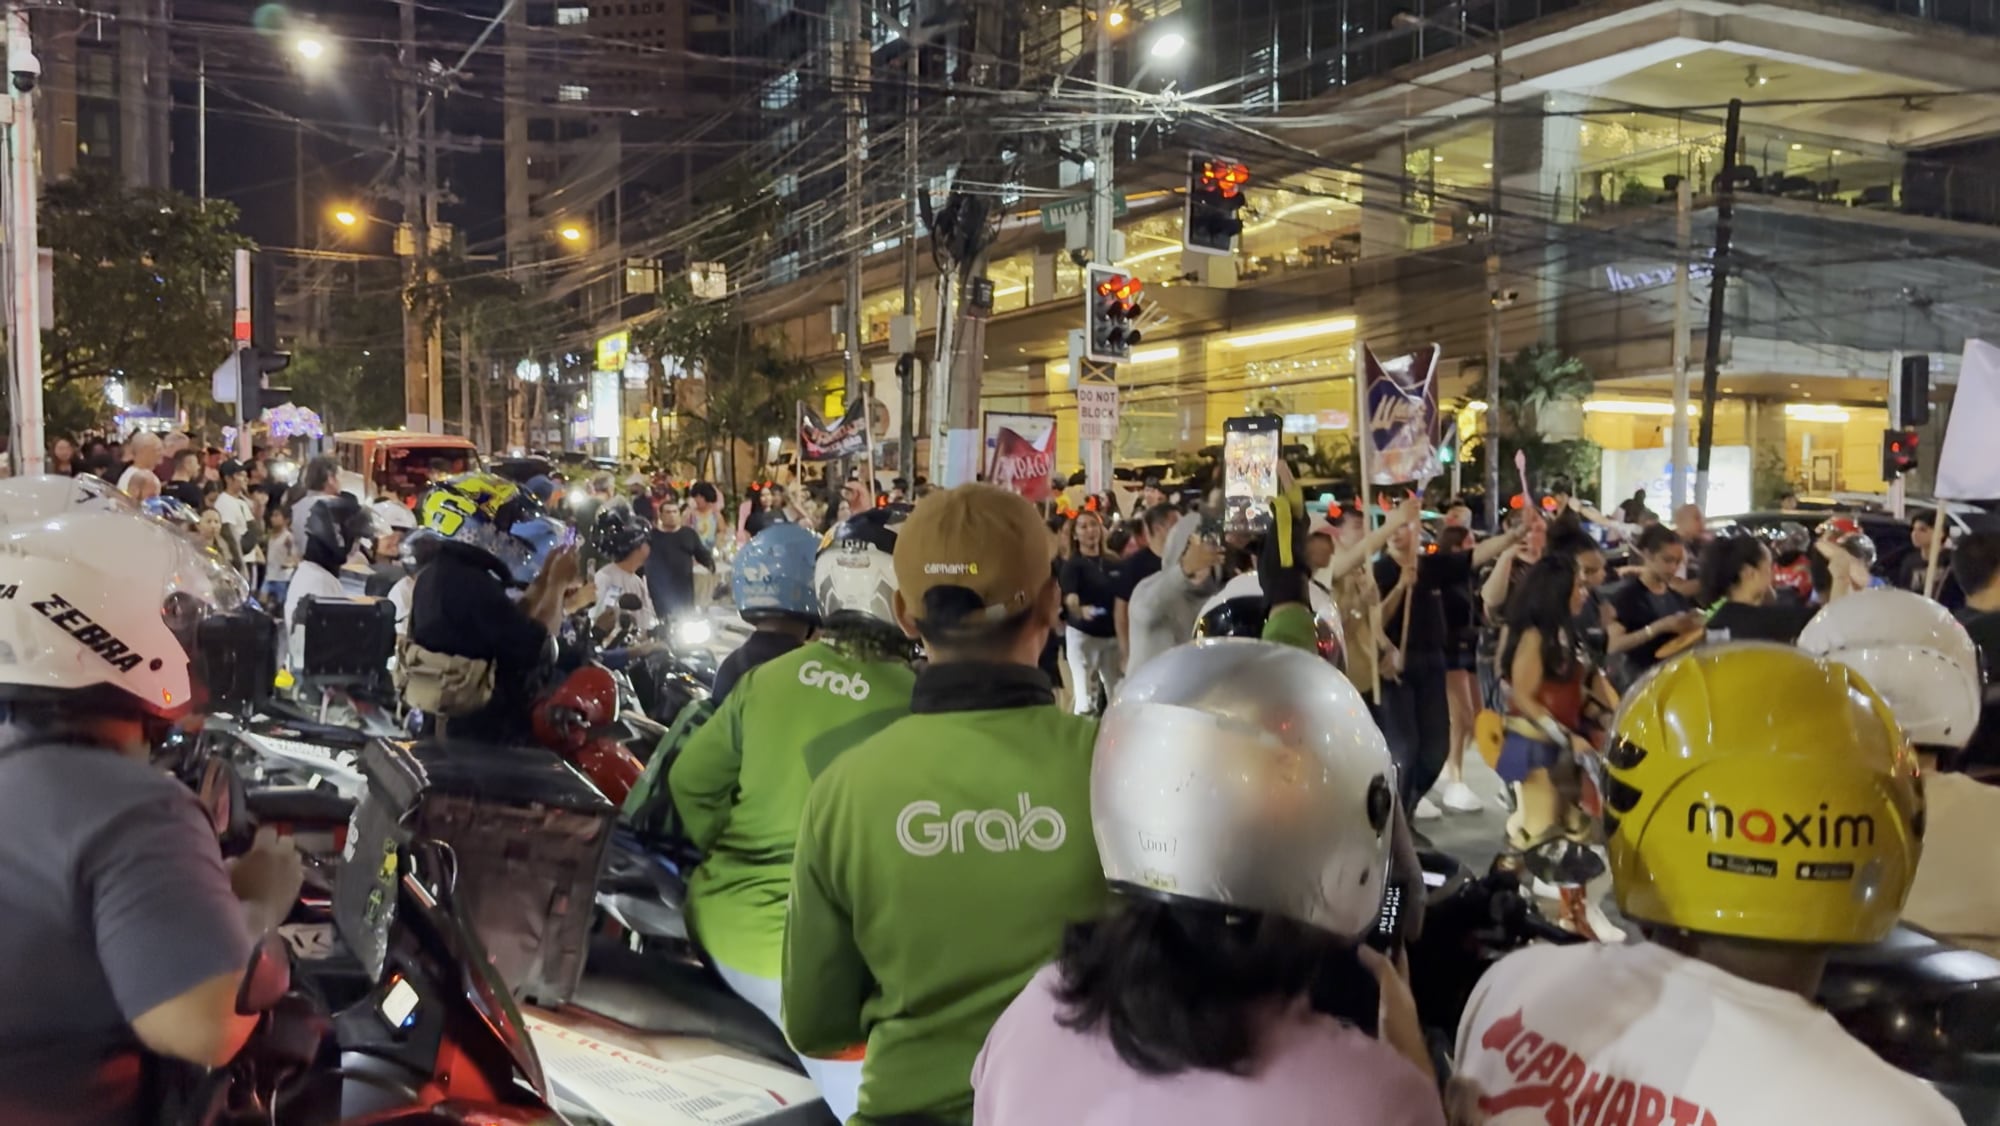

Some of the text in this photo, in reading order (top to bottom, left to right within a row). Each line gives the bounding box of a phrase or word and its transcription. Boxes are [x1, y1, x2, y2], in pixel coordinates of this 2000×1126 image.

[1080, 390, 1116, 402] DO NOT
[1081, 406, 1114, 419] BLOCK
[30, 593, 143, 673] ZEBRA
[799, 660, 870, 700] Grab
[896, 791, 1067, 857] Grab
[1688, 802, 1875, 848] maxim
